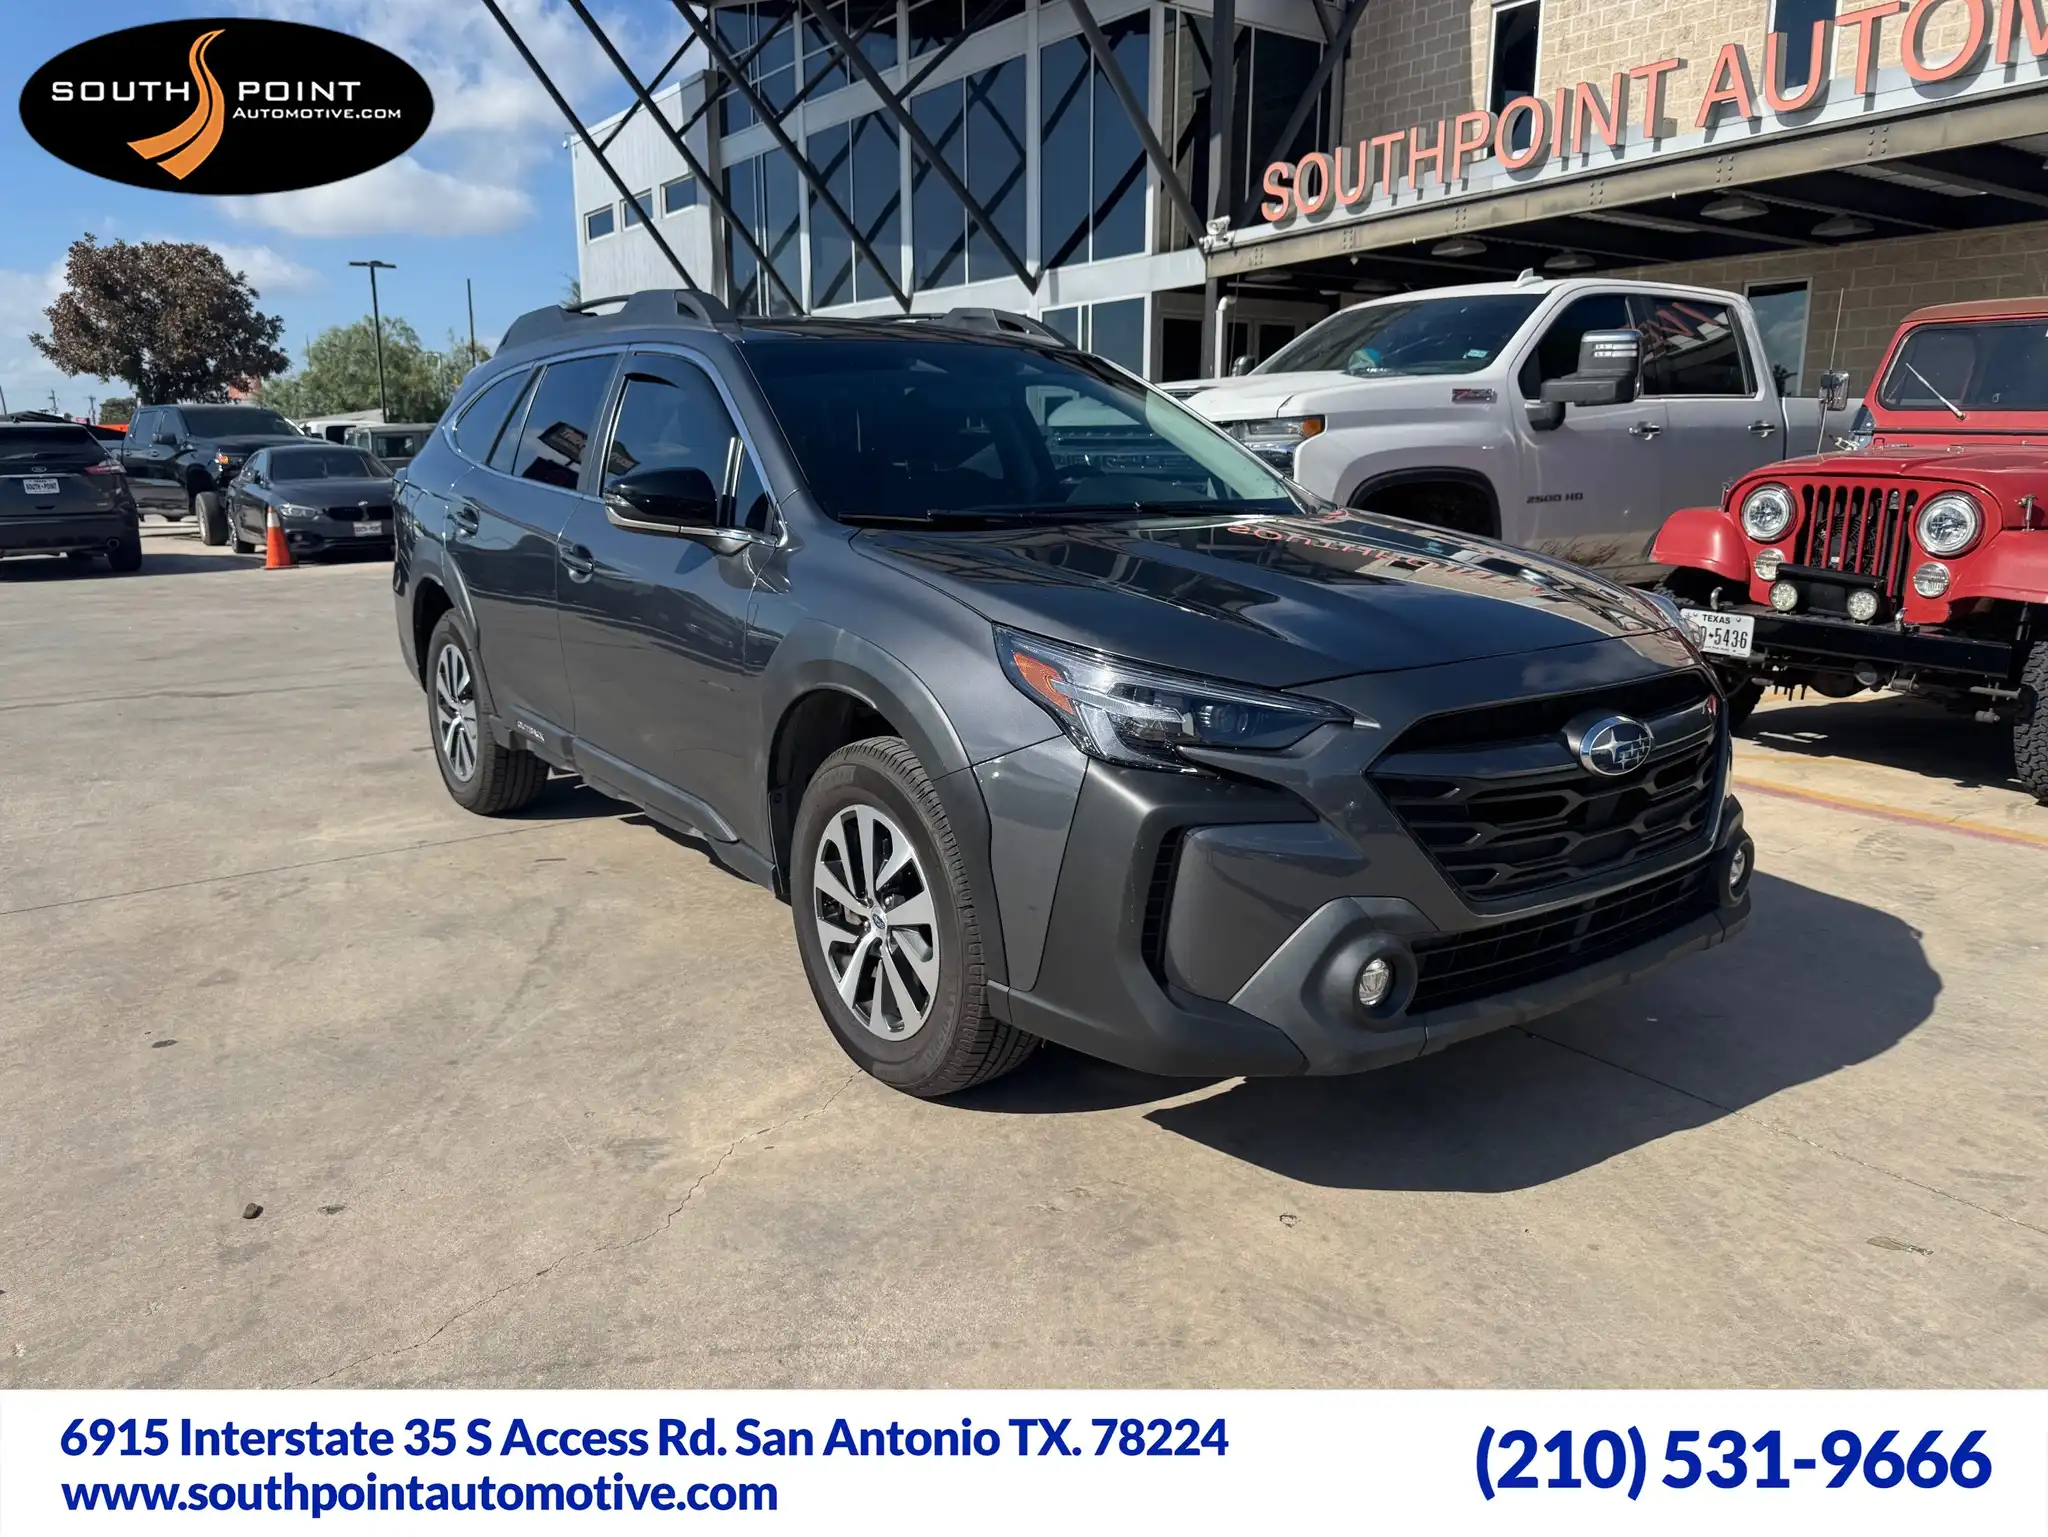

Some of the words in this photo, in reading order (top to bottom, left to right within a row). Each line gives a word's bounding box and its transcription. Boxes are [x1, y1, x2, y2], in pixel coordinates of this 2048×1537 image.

[1261, 57, 1690, 223] SOUTHPOINT
[1526, 494, 1562, 504] 2500
[1565, 492, 1584, 501] HD
[1702, 613, 1731, 625] TEXAS
